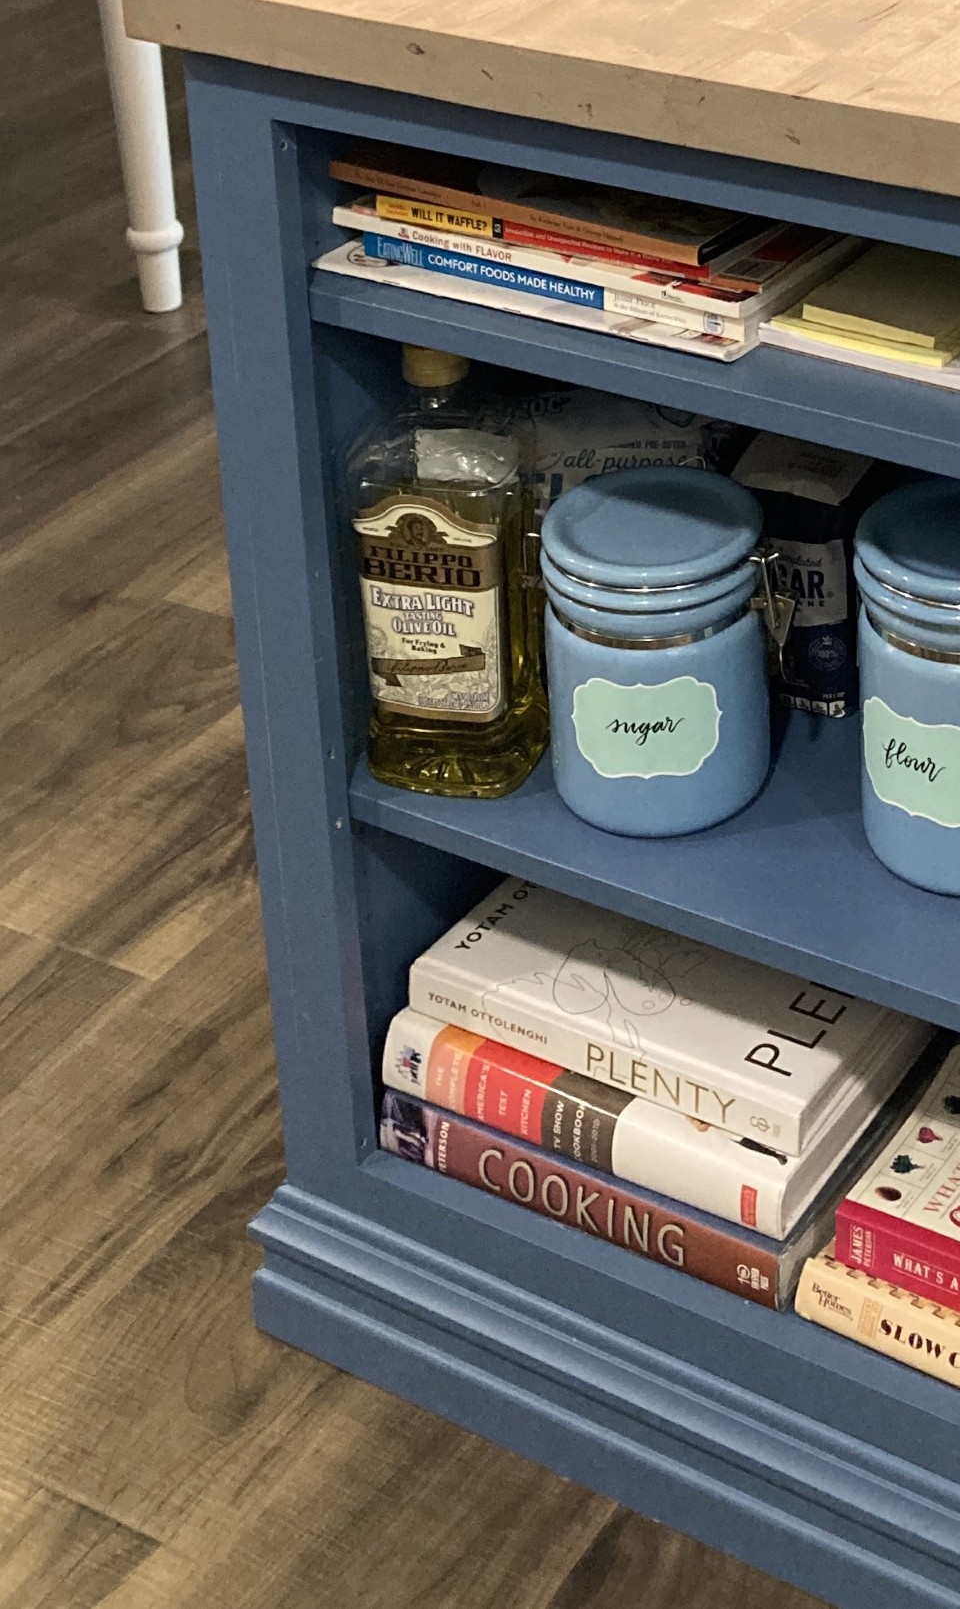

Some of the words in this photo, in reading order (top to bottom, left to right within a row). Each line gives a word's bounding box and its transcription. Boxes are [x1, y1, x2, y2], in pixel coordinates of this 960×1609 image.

[410, 206, 433, 222] WILL
[435, 212, 444, 223] IT
[446, 214, 488, 231] WAFFLE?
[412, 232, 449, 248] Cooking
[453, 241, 472, 252] with
[475, 245, 512, 262] FLAVOR
[428, 254, 478, 275] COMFORT
[480, 266, 516, 282] FOODS
[517, 273, 547, 290] MADE
[549, 281, 595, 301] HEALTHY
[363, 557, 482, 587] BERIO
[369, 545, 473, 568] FILIPPO
[370, 585, 423, 611] EXTRA
[424, 593, 475, 618] LIGHT
[403, 611, 443, 621] TASTING
[392, 617, 431, 635] OLIVE
[432, 620, 457, 637] OIL
[401, 637, 414, 645] For
[415, 639, 439, 649] Frying
[411, 645, 437, 654] Baking
[605, 716, 686, 745] sugar
[882, 738, 946, 782] flour
[454, 896, 514, 950] YOTAM
[428, 992, 468, 1013] YOTAM
[471, 1008, 547, 1044] OTTOLENGHI
[745, 982, 856, 1076] PLE
[436, 1066, 445, 1086] THE
[478, 1060, 491, 1121] AMERICA'S
[586, 1043, 736, 1124] PLENTY
[499, 1089, 509, 1116] TEST
[520, 1089, 532, 1135] KITCHEN
[554, 1101, 565, 1135] SHOW
[554, 1137, 561, 1149] TV
[573, 1102, 587, 1161] COOKBOOK
[478, 1148, 686, 1267] COOKING
[851, 1225, 863, 1264] JAMES
[863, 1230, 872, 1267] PETERSON
[893, 1252, 946, 1284] WHAT'S
[950, 1276, 959, 1291] A
[879, 1318, 946, 1360] SLOW
